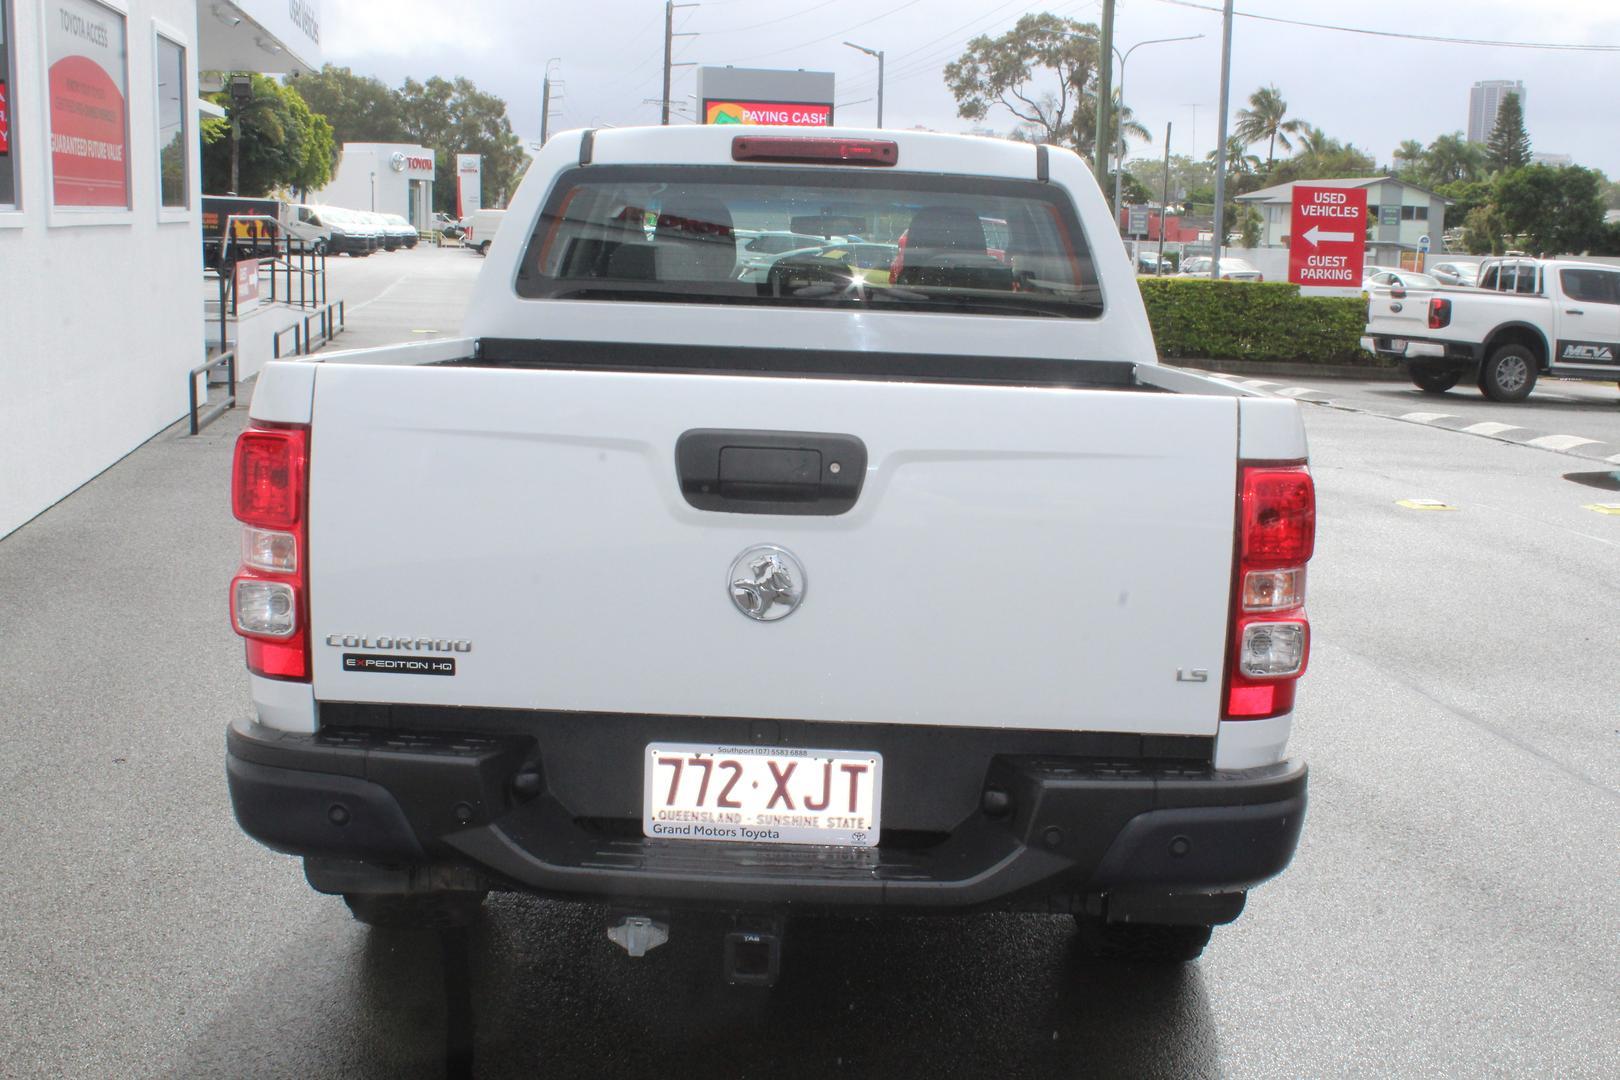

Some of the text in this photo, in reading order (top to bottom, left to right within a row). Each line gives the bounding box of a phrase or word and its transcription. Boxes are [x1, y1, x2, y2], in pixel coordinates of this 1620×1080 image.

[60, 8, 108, 48] TOYOTA ACCESS
[742, 111, 827, 124] PAYING CASH
[1314, 192, 1346, 204] USED
[1301, 204, 1359, 218] VEHICLES
[1307, 255, 1348, 267] GUEST
[1300, 268, 1353, 281] PARKING
[326, 632, 472, 653] COLORADO
[346, 658, 453, 671] EXPEDITION HQ
[1176, 667, 1208, 682] LS
[717, 746, 754, 756] Southport
[658, 810, 742, 824] QUEENSLAND
[756, 814, 819, 827] SUNSHINE
[827, 817, 865, 829] STATE
[653, 823, 780, 840] Grand Motors Toyota
